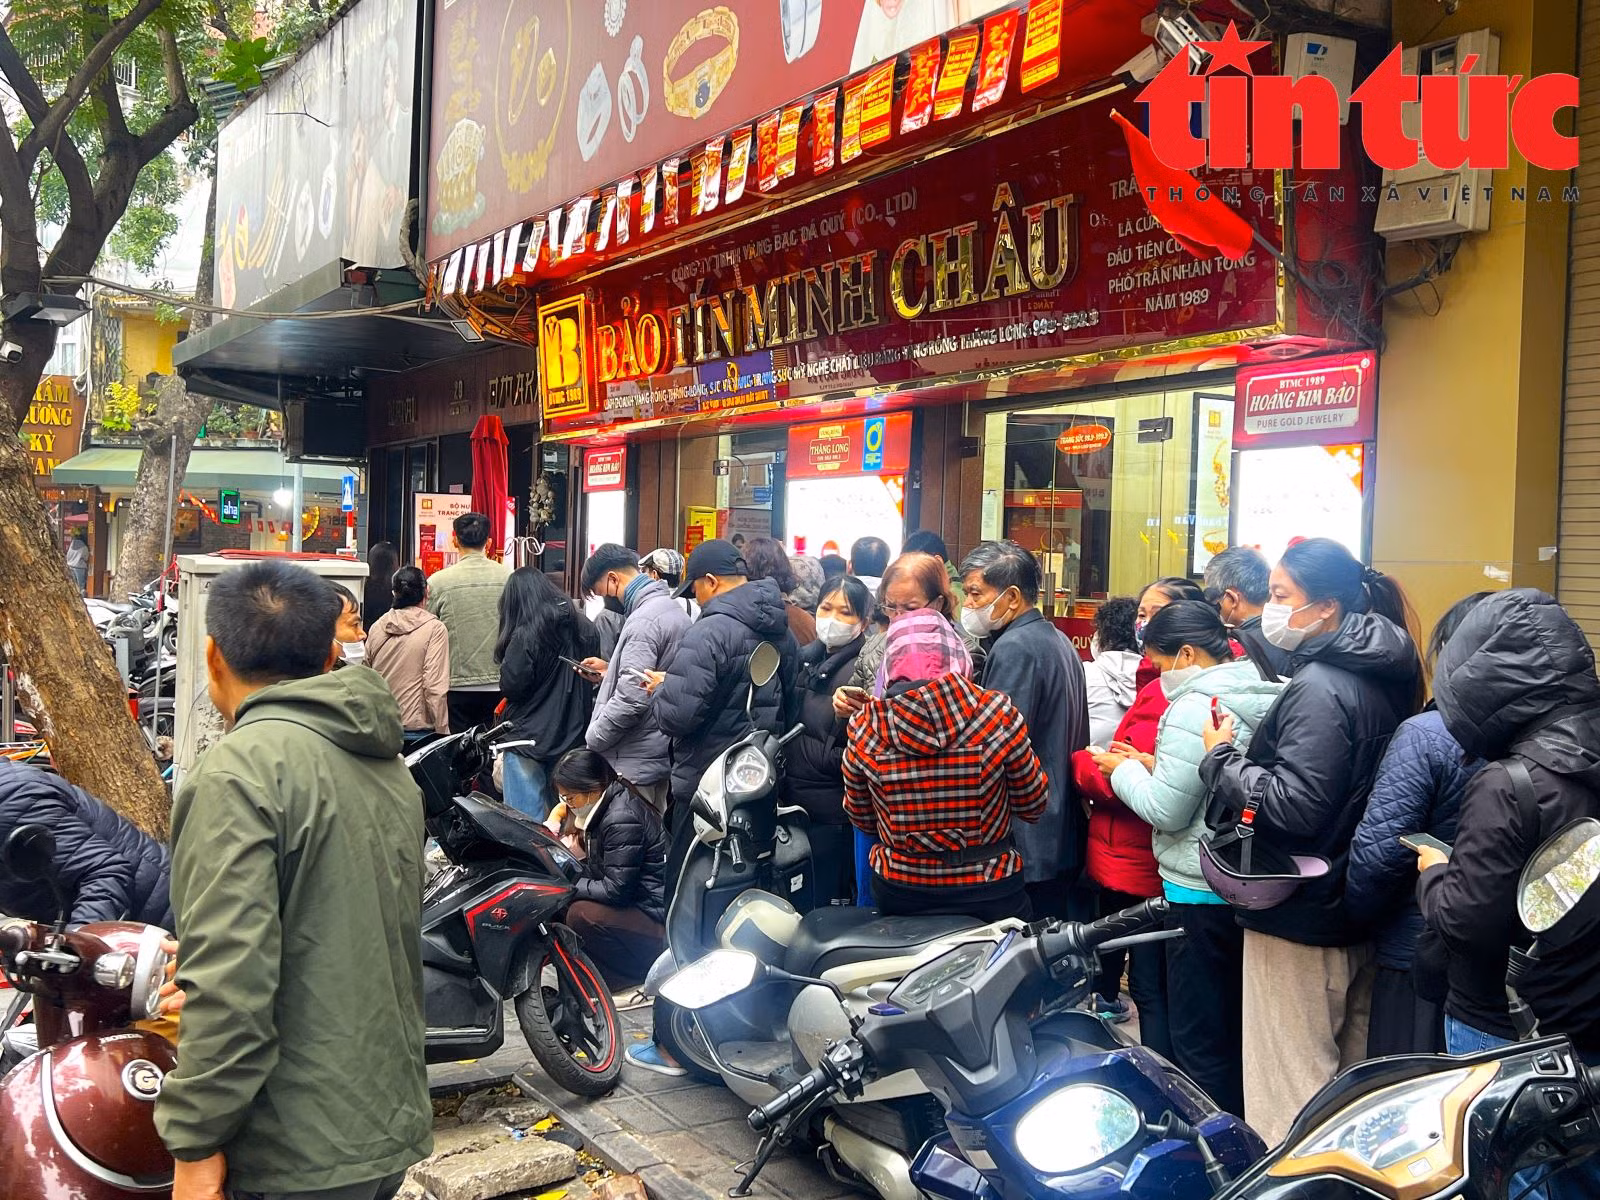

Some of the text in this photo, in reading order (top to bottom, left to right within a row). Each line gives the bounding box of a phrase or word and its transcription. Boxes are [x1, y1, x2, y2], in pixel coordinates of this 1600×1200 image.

[774, 230, 798, 252] BẠC
[820, 208, 846, 237] QUÝ
[1172, 258, 1213, 281] NHÂN
[598, 181, 1078, 383] BẢO TÍN MINH CHÂU
[1145, 287, 1210, 313] NĂM 1989
[1279, 375, 1326, 389] BTMC 1989
[1250, 380, 1356, 413] HOÀNG KIM BẢO
[1257, 414, 1345, 429] PURE GOLD JEWELRY
[30, 429, 56, 453] KỲ
[832, 443, 849, 454] LONG
[224, 500, 238, 515] aha
[99, 1033, 144, 1044] HONDA
